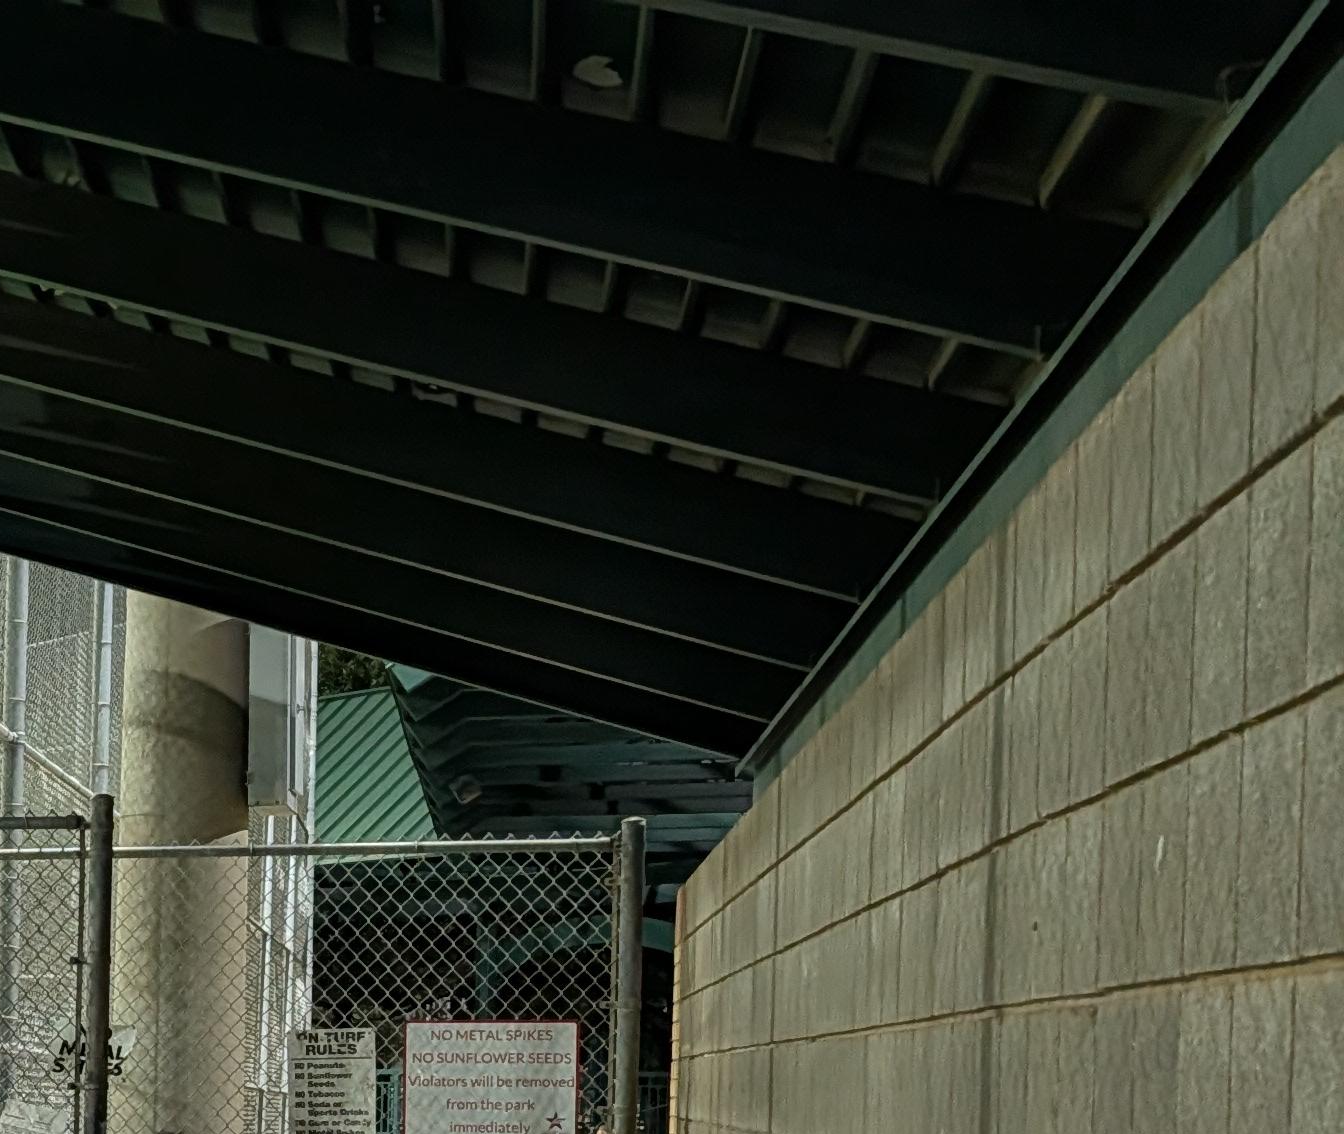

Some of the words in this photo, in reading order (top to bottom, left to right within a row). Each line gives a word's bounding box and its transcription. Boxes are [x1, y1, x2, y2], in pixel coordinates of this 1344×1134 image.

[430, 1029, 453, 1041] NO
[456, 1029, 503, 1041] METAL
[505, 1029, 553, 1041] SPIKES
[305, 1043, 358, 1056] RULES
[412, 1052, 434, 1064] NO
[436, 1052, 525, 1064] SUNFLOWER
[528, 1052, 573, 1065] SEEDS
[408, 1075, 468, 1088] Violators
[470, 1075, 494, 1088] will
[496, 1075, 513, 1088] be
[515, 1075, 575, 1088] removed
[446, 1098, 478, 1110] from
[480, 1098, 503, 1110] the
[505, 1098, 536, 1112] park
[449, 1121, 531, 1134] immediately
